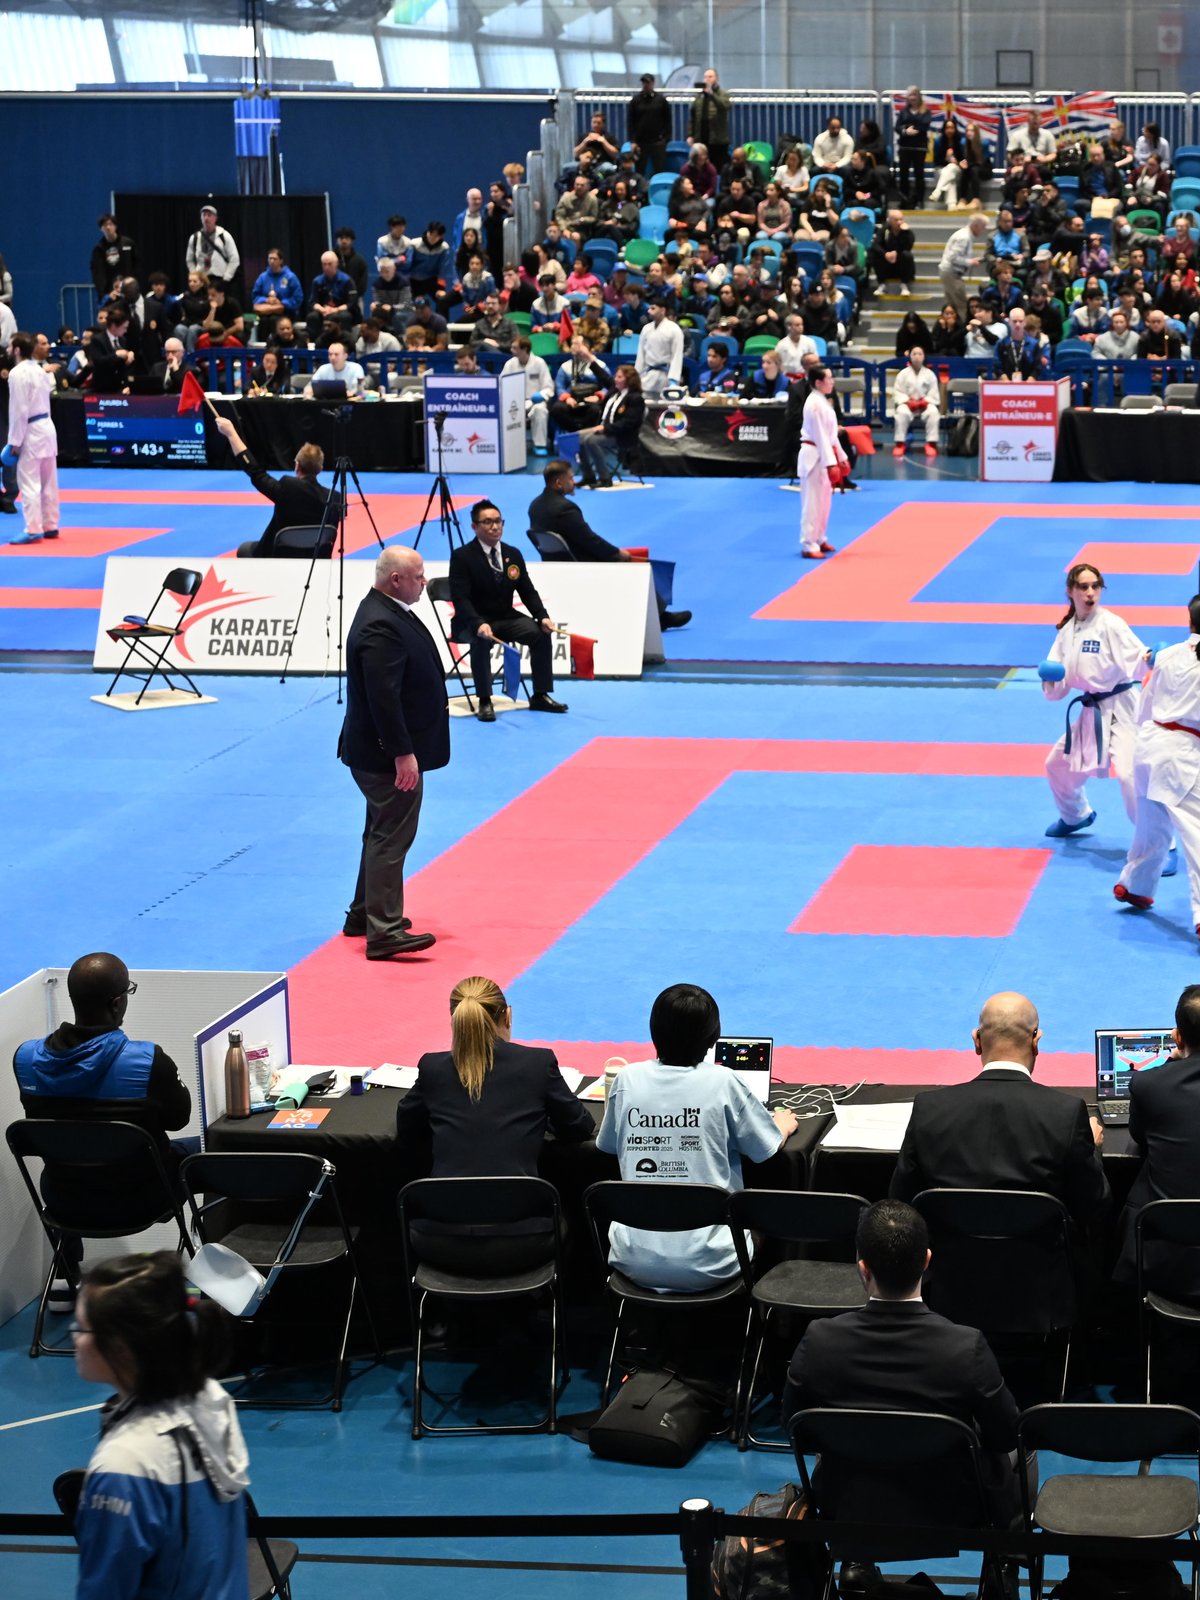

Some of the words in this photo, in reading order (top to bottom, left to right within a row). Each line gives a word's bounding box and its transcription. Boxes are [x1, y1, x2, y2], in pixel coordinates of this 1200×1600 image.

[445, 392, 479, 401] COACH
[1001, 399, 1037, 409] COACH
[194, 422, 204, 435] 0
[738, 425, 769, 434] KARATE
[738, 433, 769, 442] CANADA
[210, 618, 295, 636] KARATE
[208, 638, 292, 656] CANADA
[627, 1107, 701, 1128] Canada
[626, 1133, 672, 1145] viaSPORT
